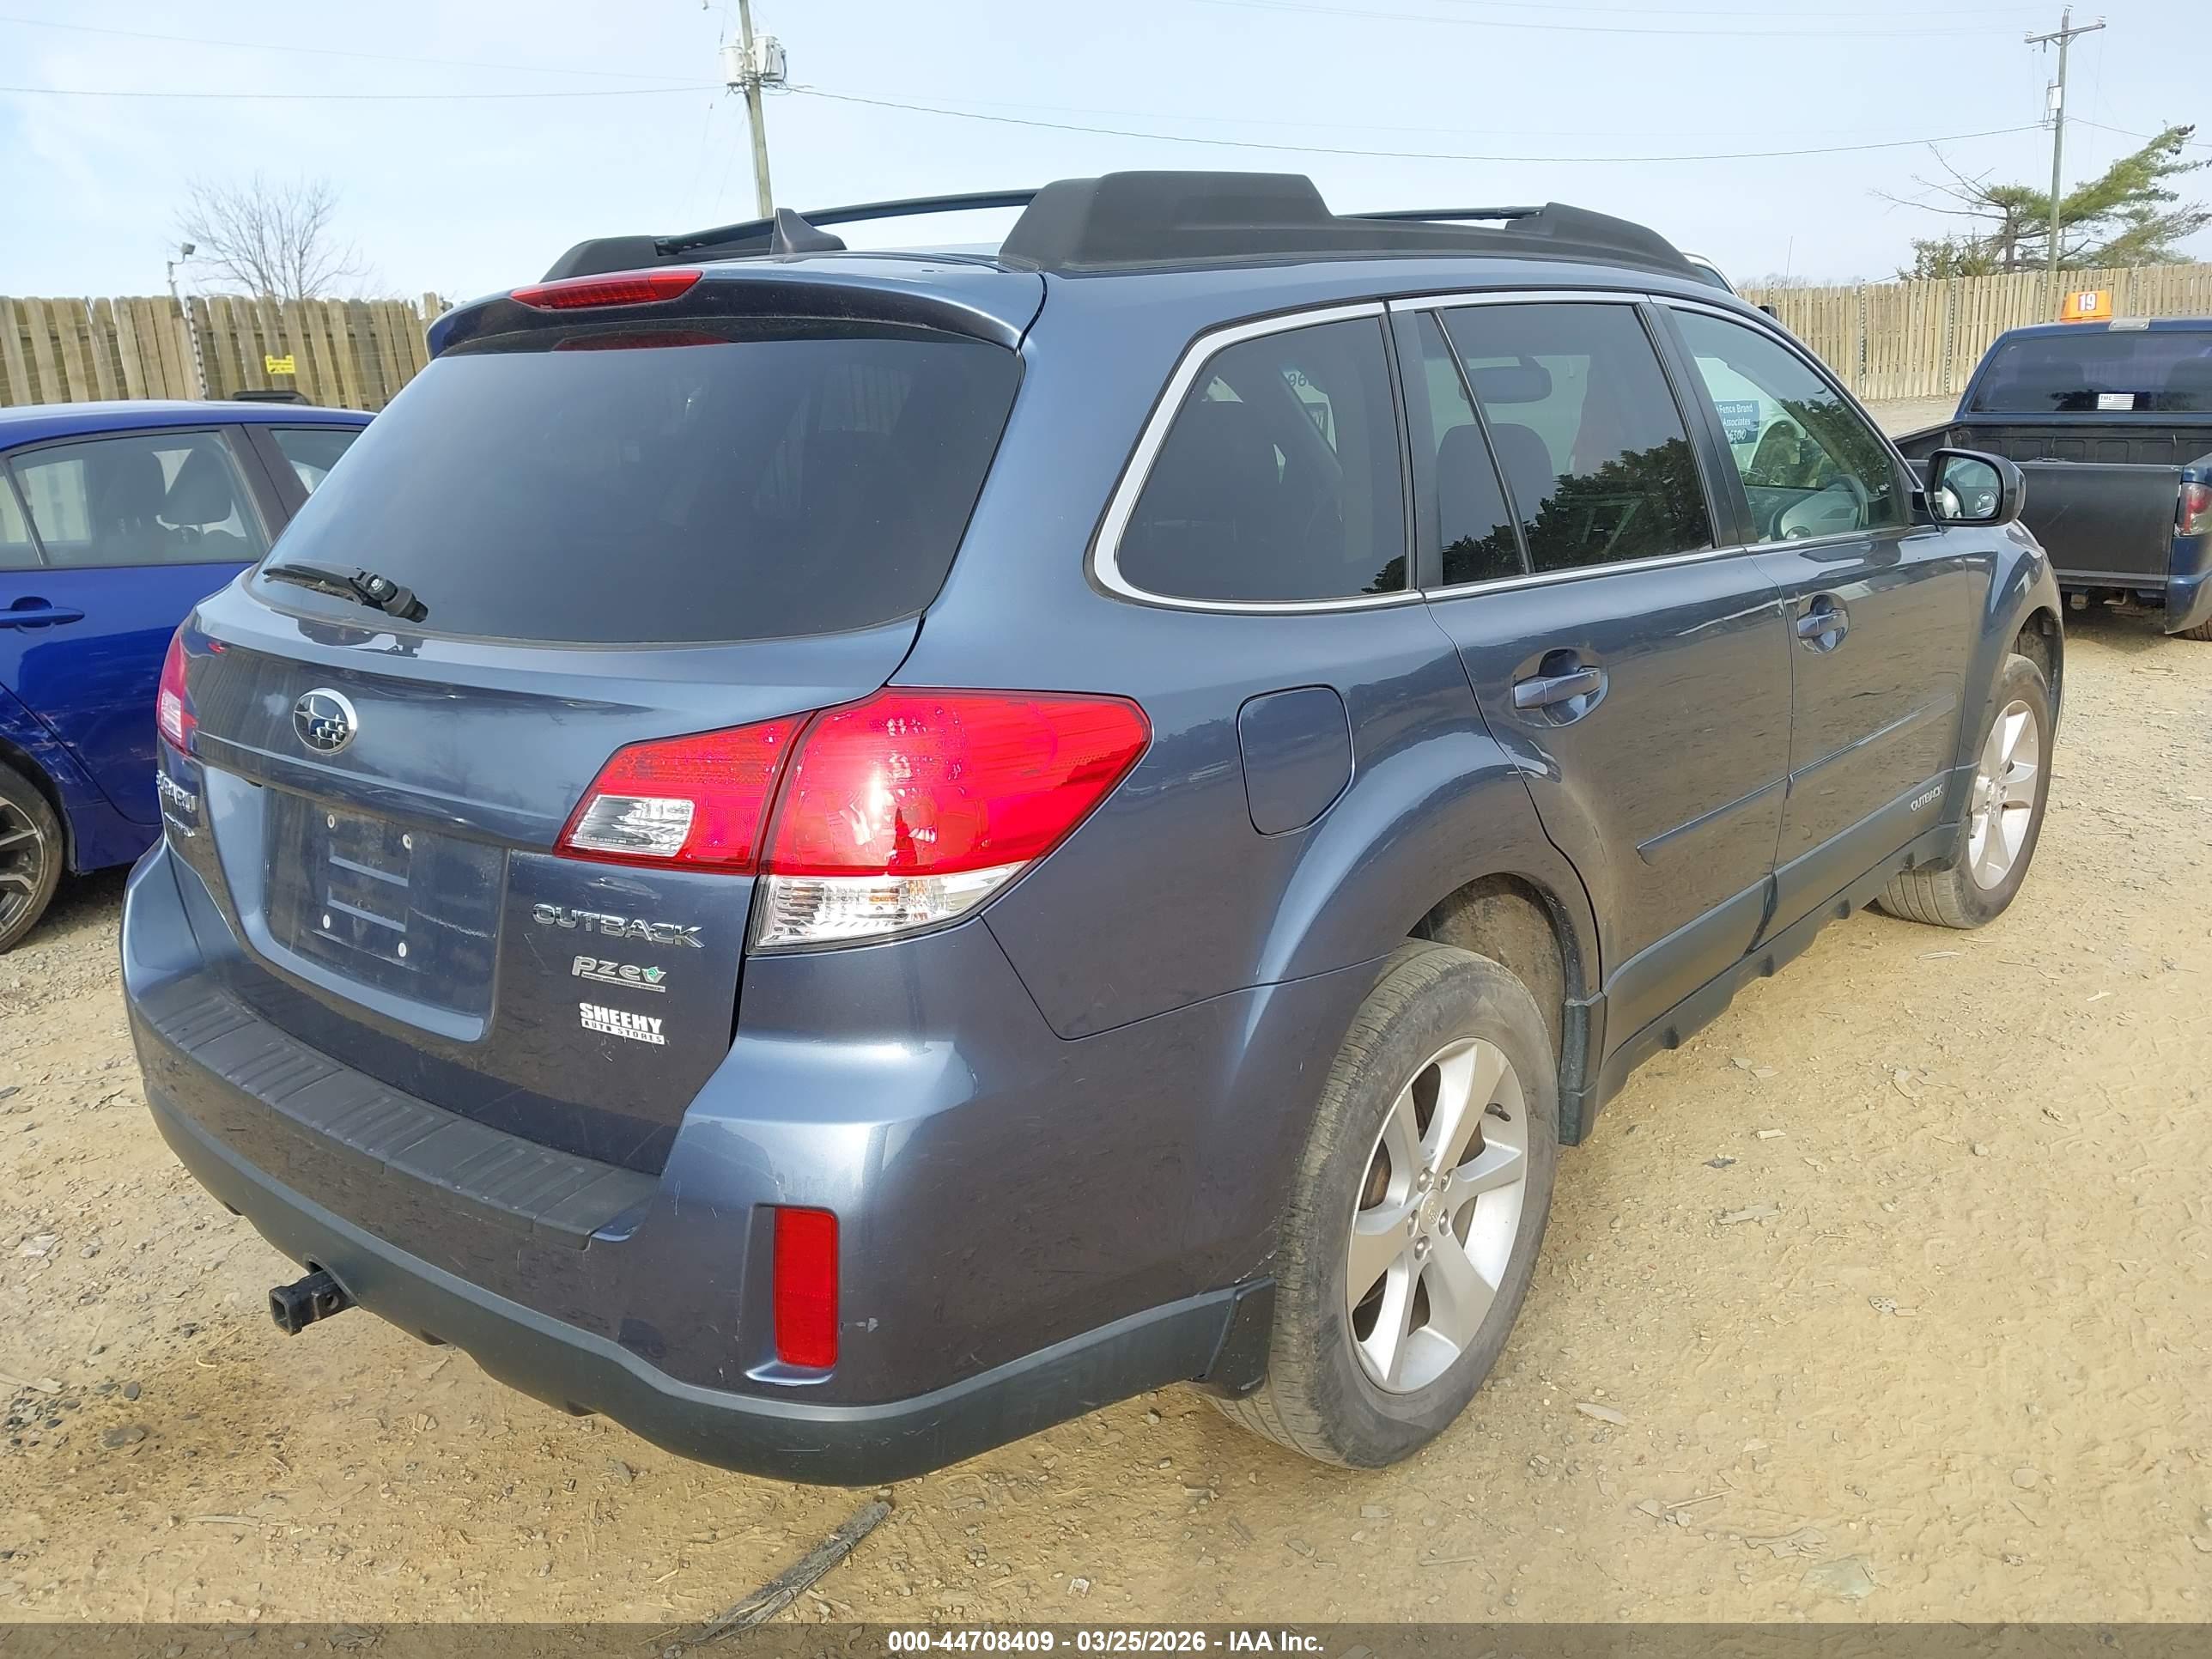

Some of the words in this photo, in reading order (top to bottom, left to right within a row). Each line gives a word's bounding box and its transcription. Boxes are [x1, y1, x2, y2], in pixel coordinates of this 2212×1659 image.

[2079, 293, 2096, 310] 19
[1718, 404, 1735, 413] Fence
[1736, 403, 1753, 413] Brand
[1723, 416, 1751, 427] Associates
[1911, 783, 1943, 811] OUTBACK
[532, 903, 706, 949] OUTBACK
[579, 1002, 663, 1034] SHEEHY
[585, 1020, 612, 1032] AUTO
[618, 1029, 662, 1043] STORES
